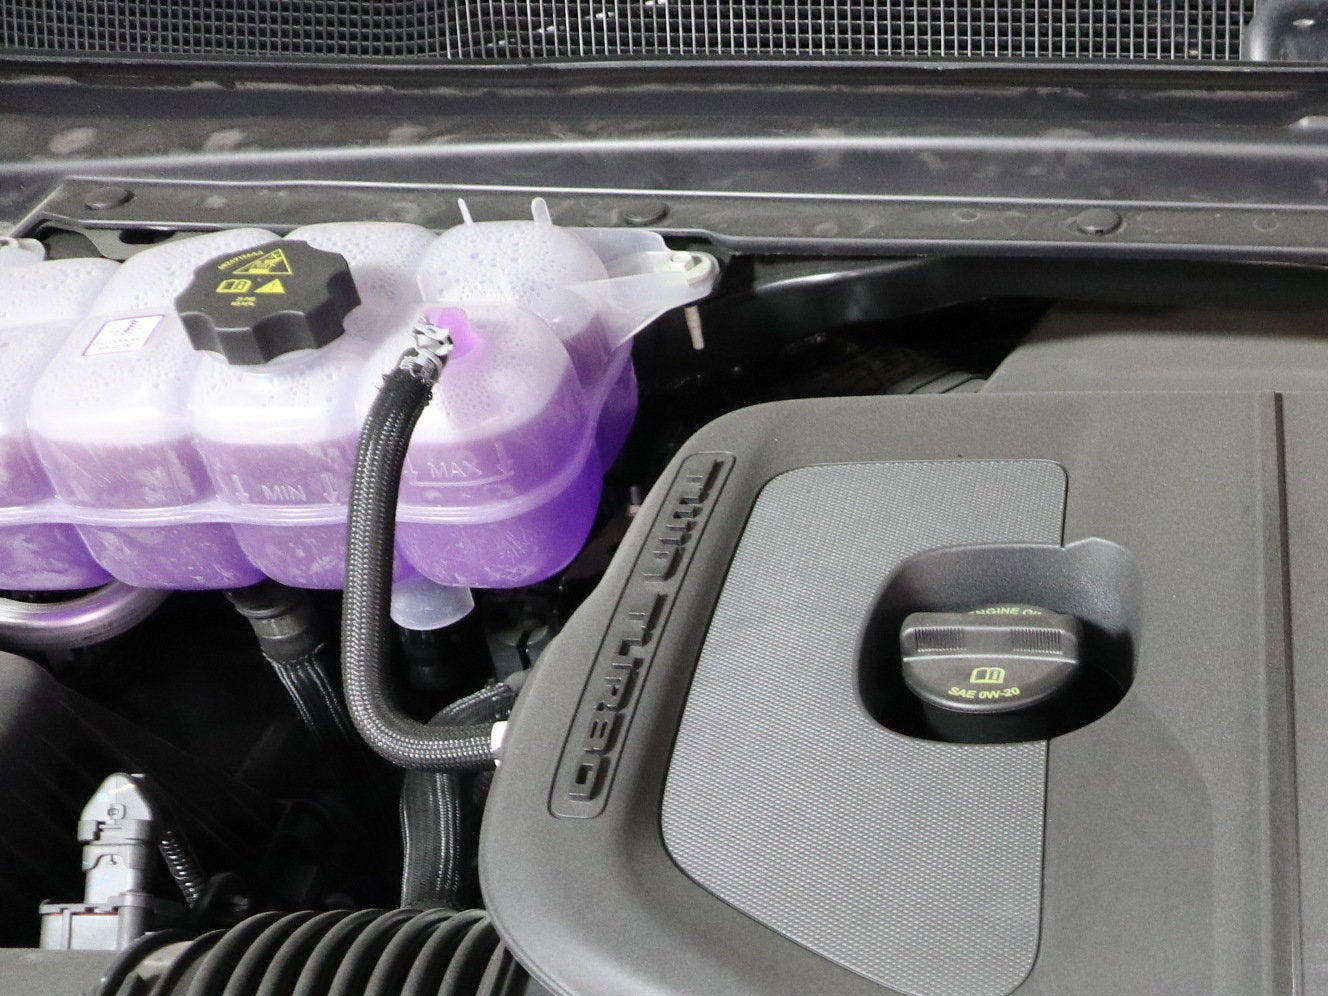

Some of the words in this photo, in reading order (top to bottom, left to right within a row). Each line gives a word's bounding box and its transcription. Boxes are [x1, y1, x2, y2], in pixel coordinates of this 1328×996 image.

[427, 460, 482, 478] MAX
[261, 484, 307, 501] MIN
[968, 607, 1019, 615] NGINE
[568, 592, 668, 802] TURBO
[948, 686, 976, 699] SAE
[978, 687, 1020, 699] 0W-20
